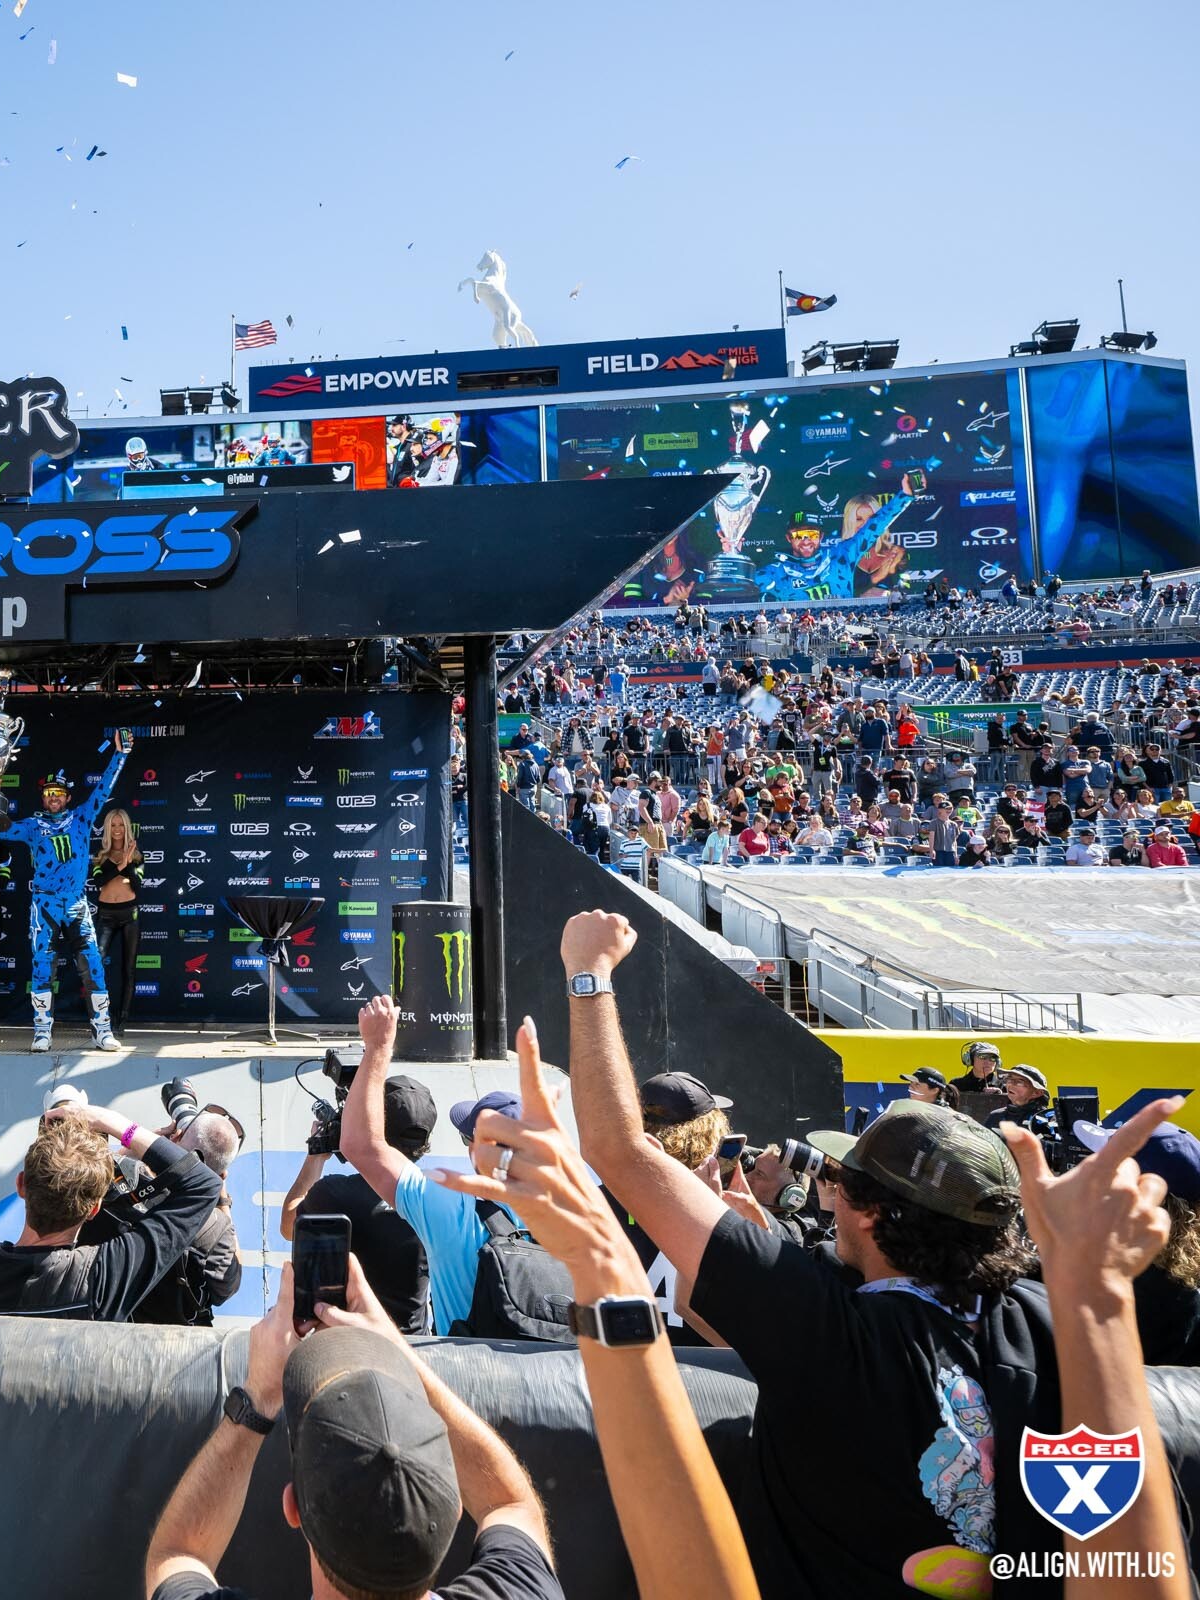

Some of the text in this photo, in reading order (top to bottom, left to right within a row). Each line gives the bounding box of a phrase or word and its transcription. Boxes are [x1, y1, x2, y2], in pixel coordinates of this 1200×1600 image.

[728, 345, 757, 356] MILE
[325, 353, 659, 393] EMPOWER FIELD
[815, 426, 848, 437] YAMAHA
[657, 437, 695, 446] Kawasaki
[962, 538, 1017, 547] OAKLEY
[313, 717, 382, 736] AMA
[337, 794, 377, 808] WPS
[230, 822, 270, 836] WPS
[144, 850, 165, 864] PS
[241, 958, 264, 966] YAMAHA
